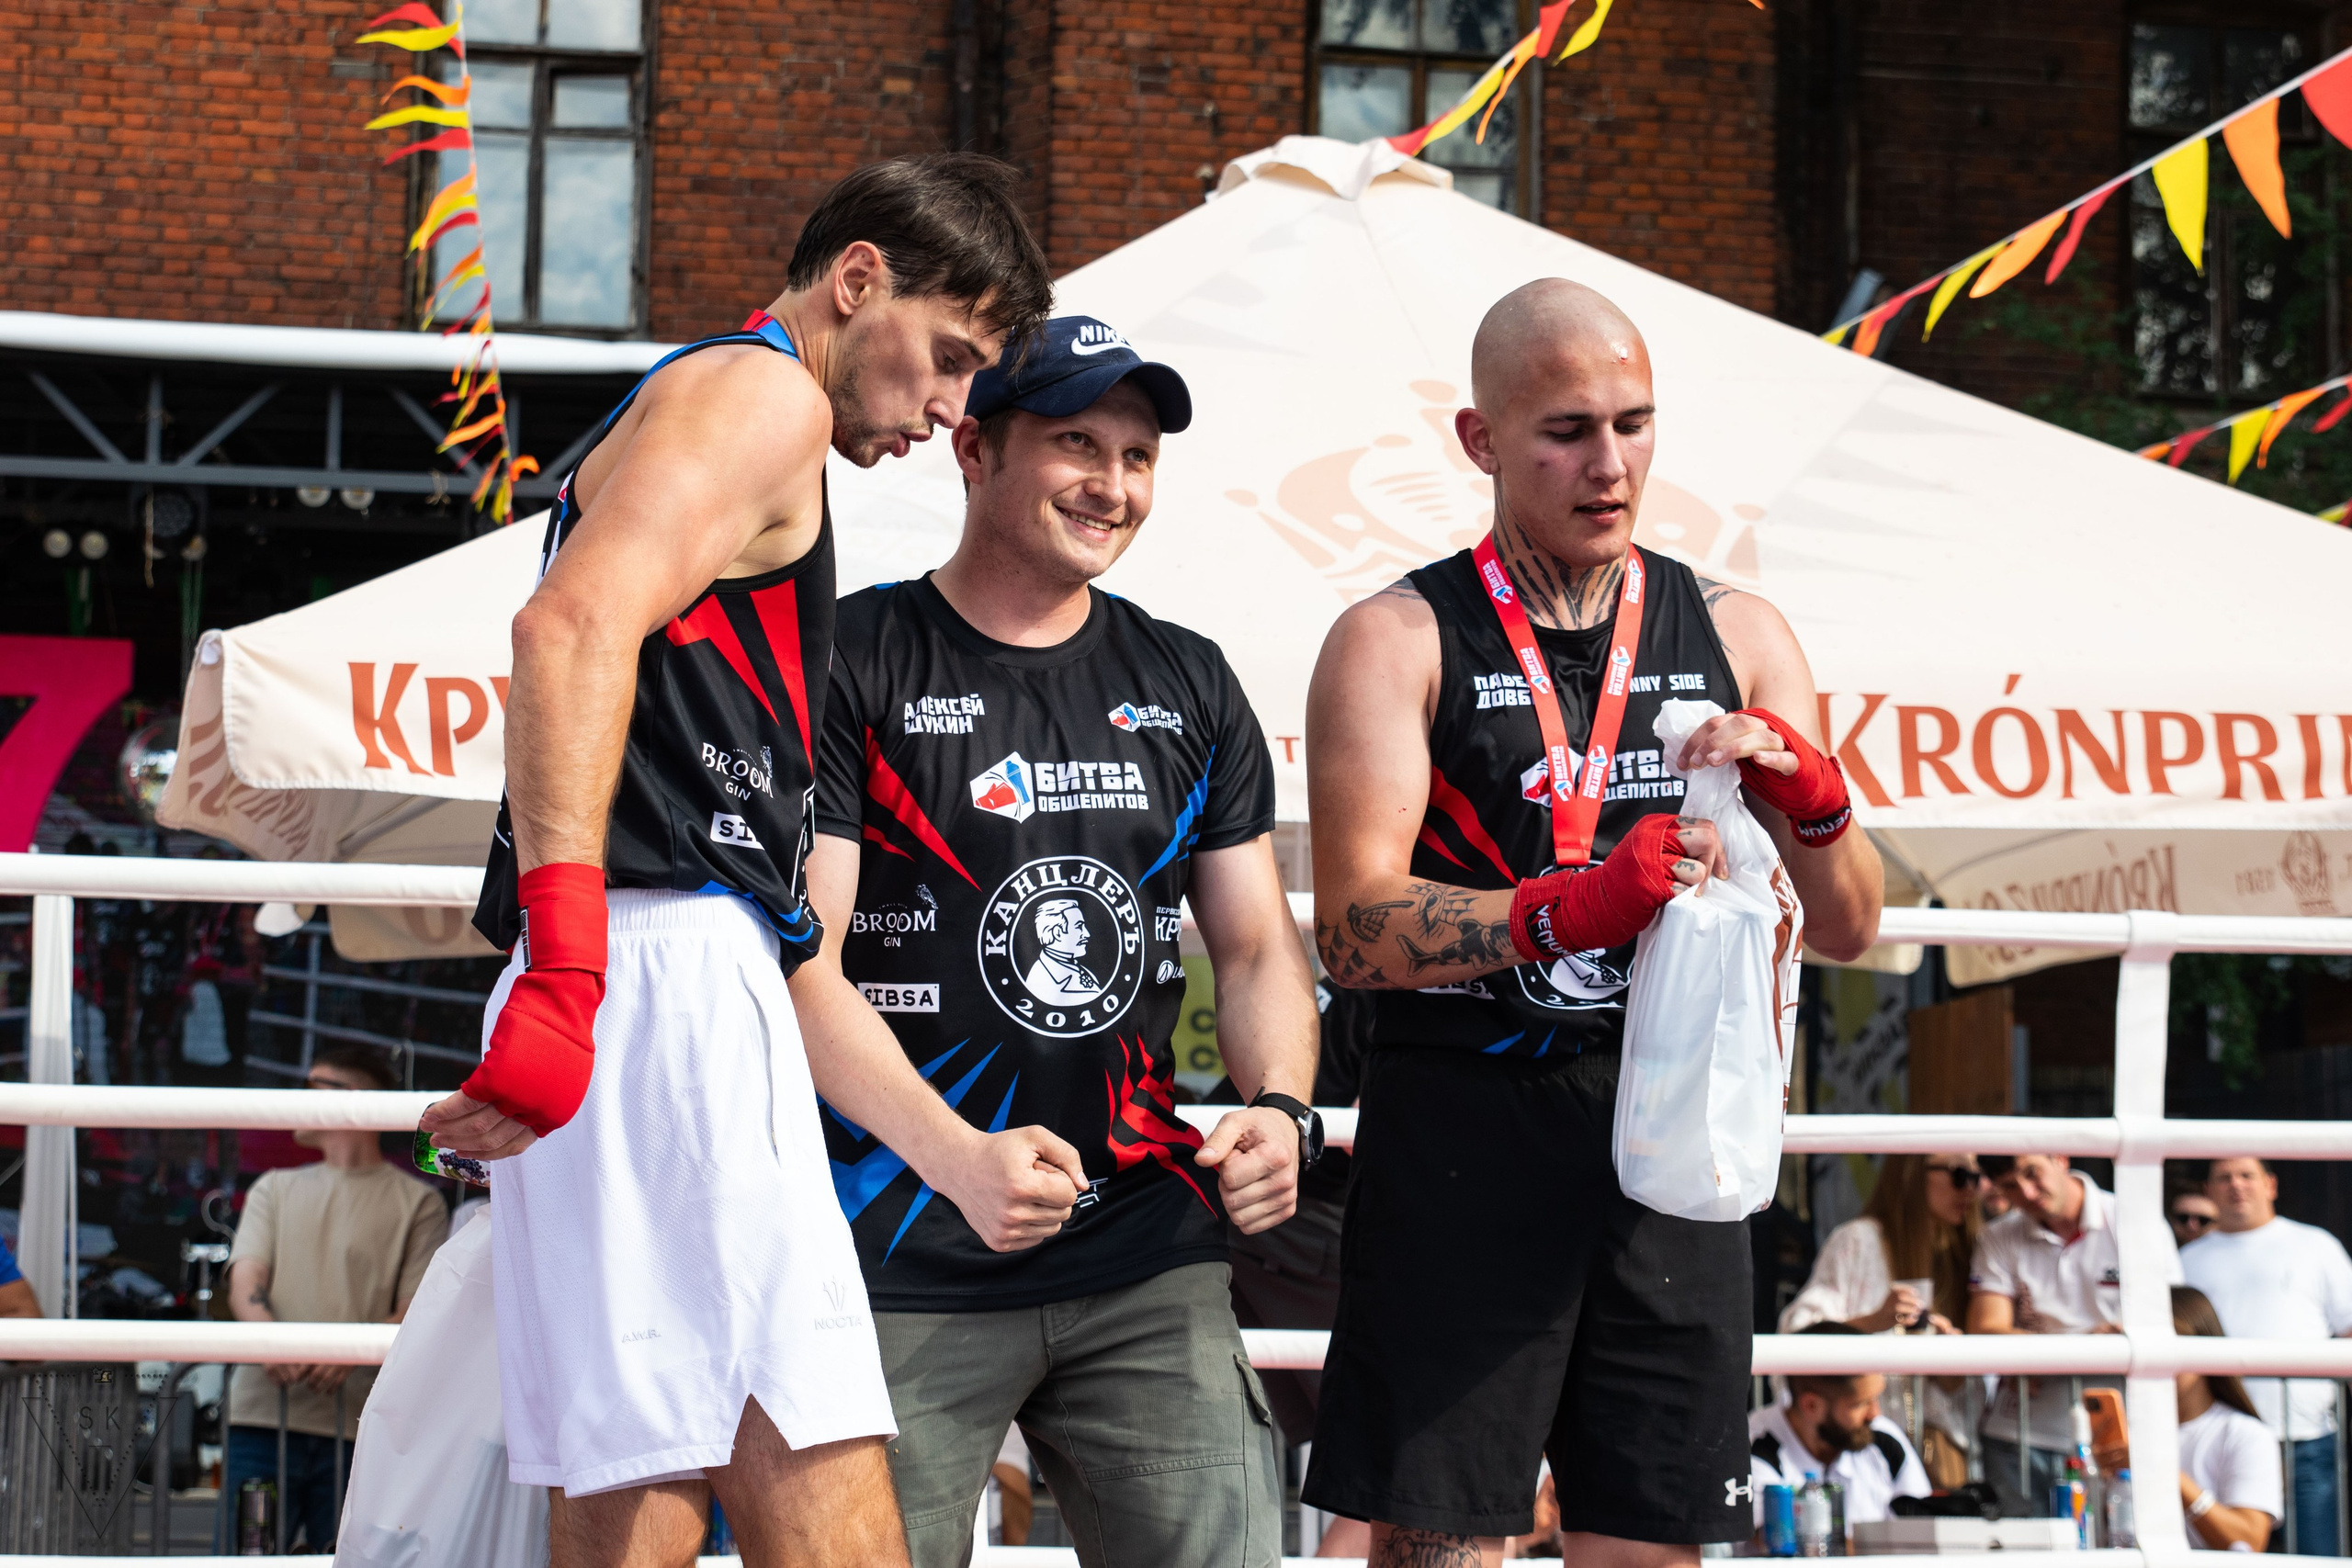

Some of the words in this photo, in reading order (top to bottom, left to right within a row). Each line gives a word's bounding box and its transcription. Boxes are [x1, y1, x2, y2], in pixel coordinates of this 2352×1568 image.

[1474, 671, 1531, 691] ПАВЕ
[1668, 673, 1706, 691] SIDE
[904, 693, 986, 721] АЛЕКСЕЙ
[1476, 688, 1535, 710] ДОВБ
[701, 741, 775, 799] BROOM
[1034, 761, 1147, 793] БИТВА
[725, 782, 752, 801] GIN
[1037, 793, 1149, 814] ОБЩЕПИТОВ
[852, 909, 937, 933] BROOM
[985, 863, 1140, 957] КАНЦЛЕРЪ
[883, 936, 901, 948] GIN
[1015, 994, 1120, 1028] 2010
[814, 1314, 863, 1331] NOCTA
